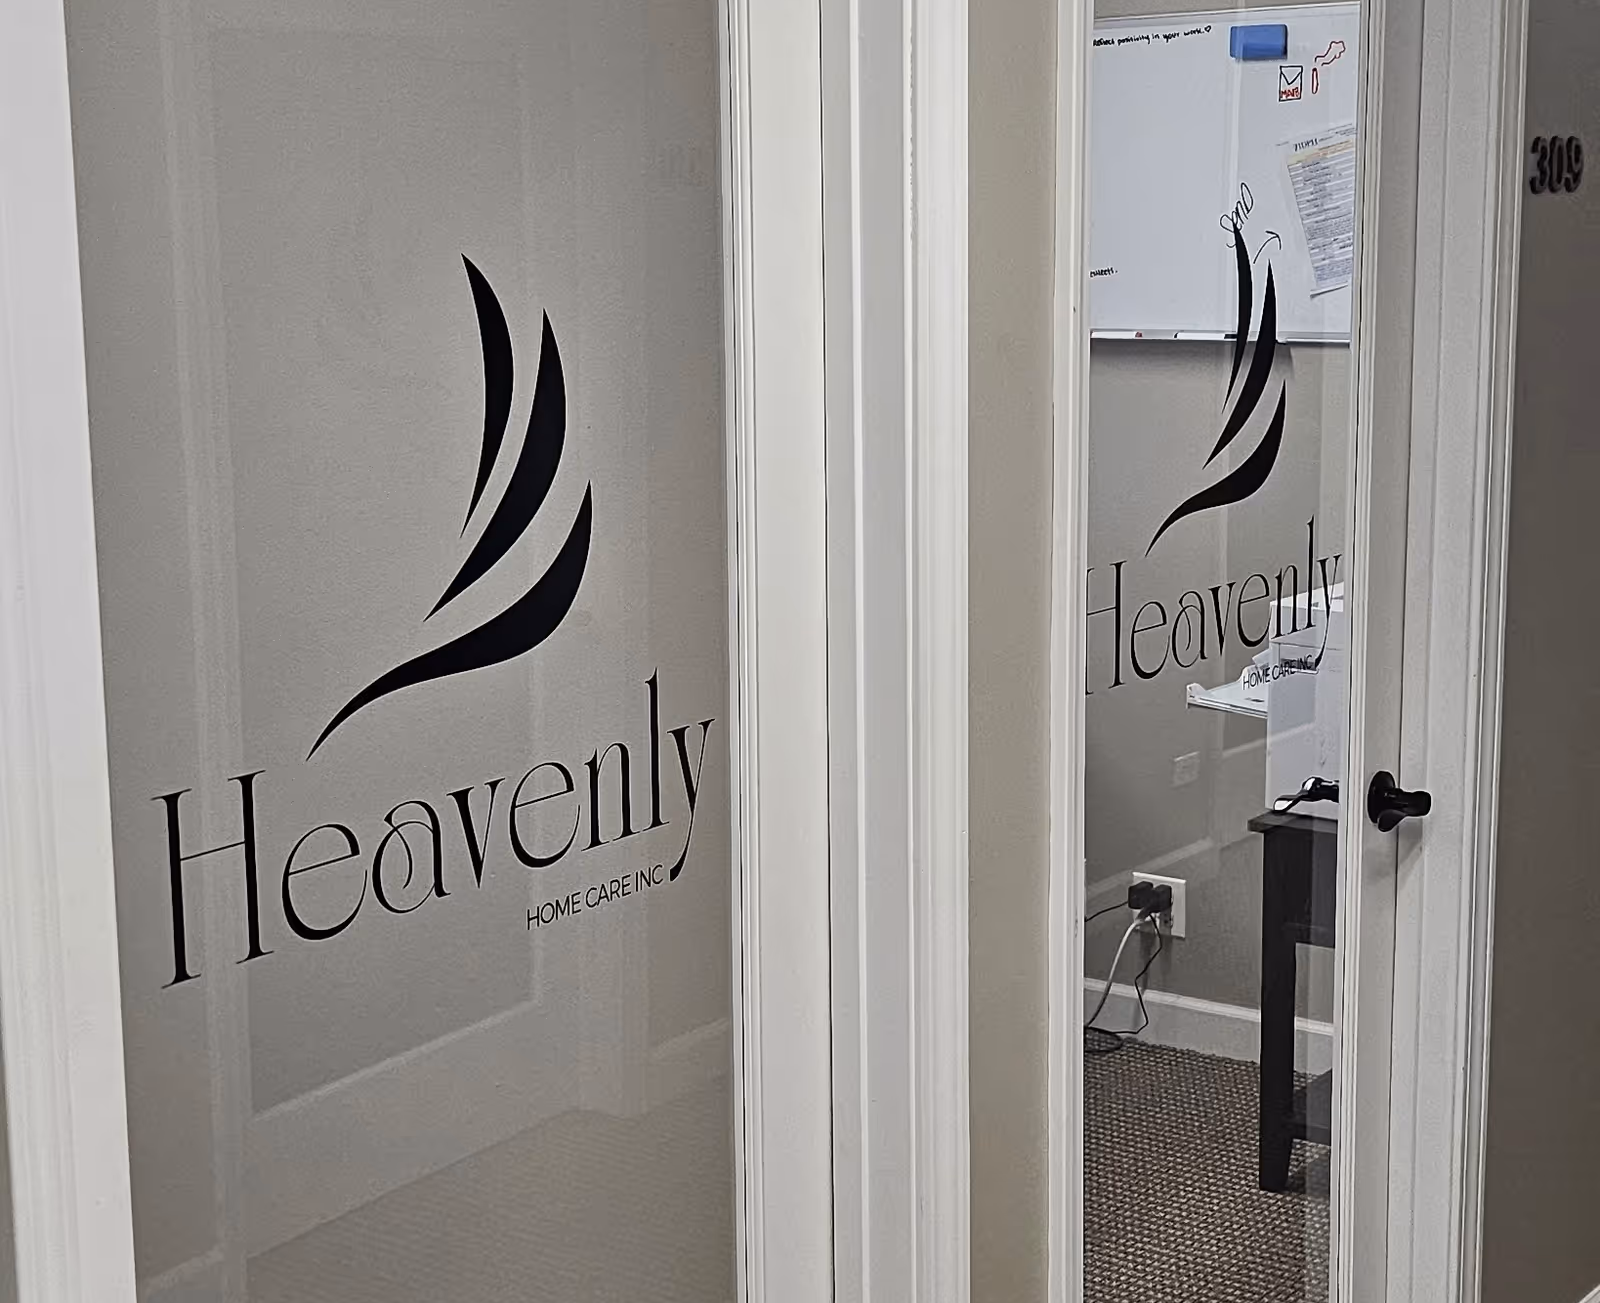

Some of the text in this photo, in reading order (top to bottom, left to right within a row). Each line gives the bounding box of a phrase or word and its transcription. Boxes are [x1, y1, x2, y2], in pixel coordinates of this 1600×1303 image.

[1529, 135, 1585, 195] 309
[1085, 514, 1343, 696] Heavenly
[1242, 654, 1313, 691] HOME CARE INC
[151, 667, 716, 990] Heavenly
[526, 864, 664, 931] HOME CARE INC
